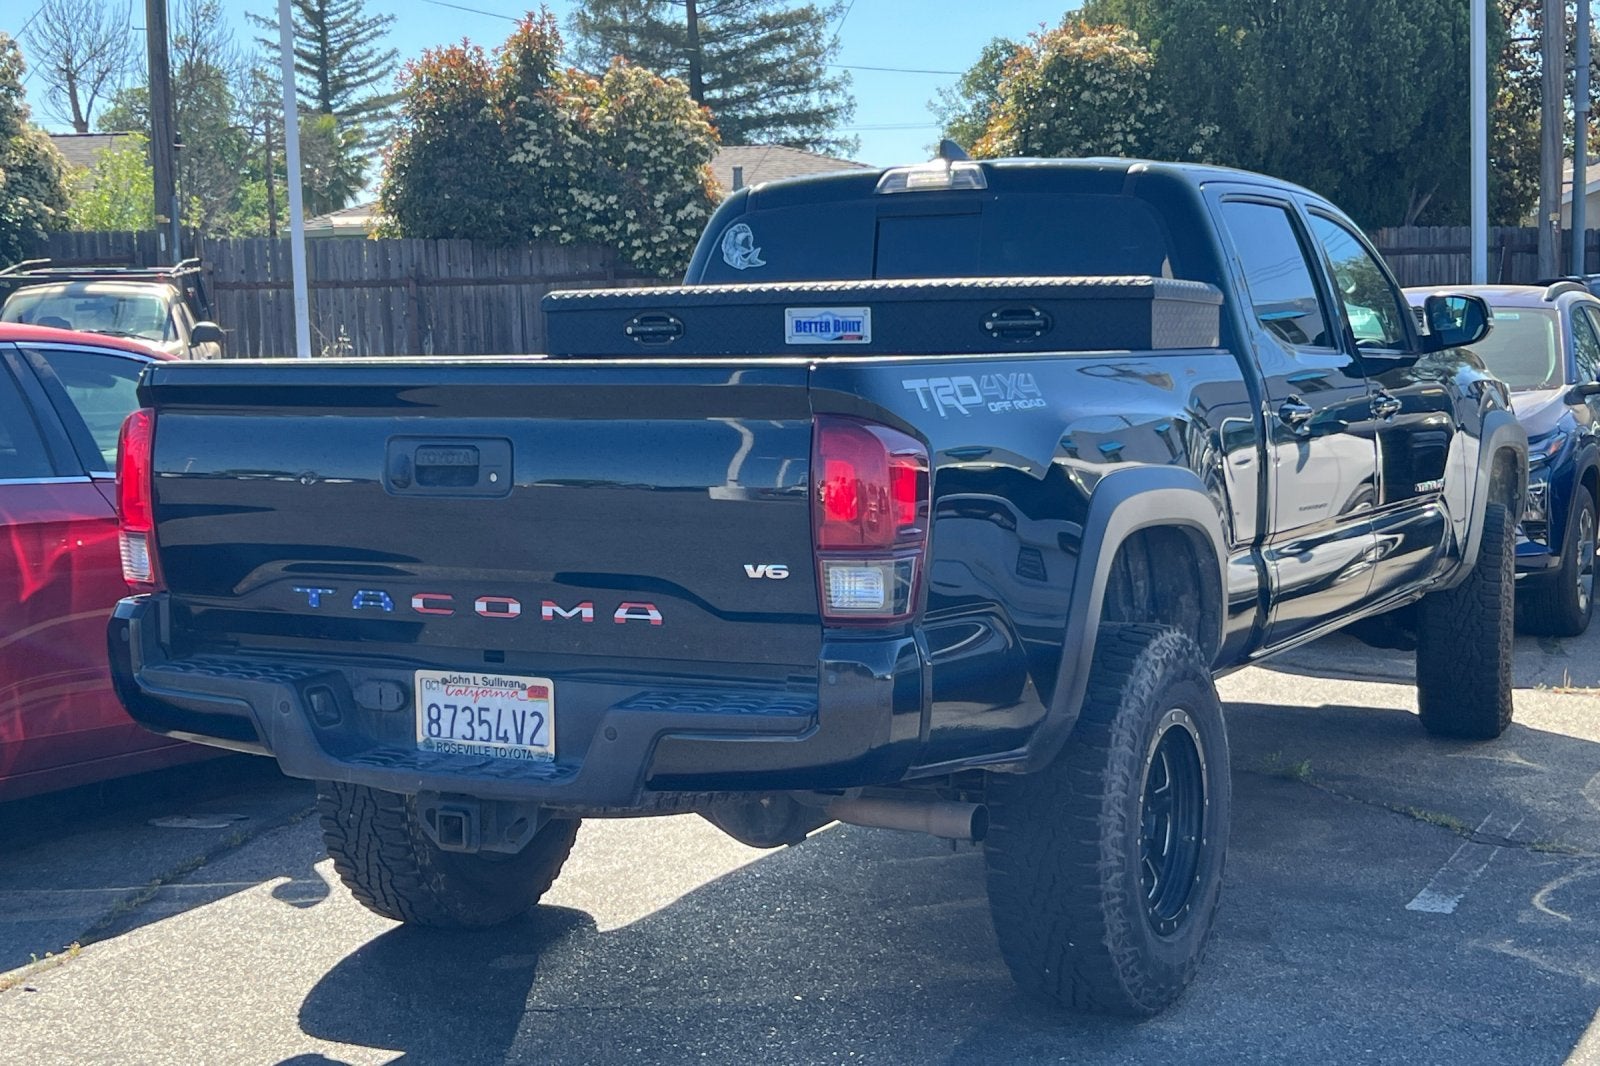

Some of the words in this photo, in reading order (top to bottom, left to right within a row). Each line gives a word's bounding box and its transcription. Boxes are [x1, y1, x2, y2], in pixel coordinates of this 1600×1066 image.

[794, 319, 831, 333] BETTER
[833, 319, 862, 333] BUILT
[901, 375, 983, 417] TRD
[988, 401, 1012, 412] OFF
[1013, 398, 1046, 410] ROAD
[743, 564, 789, 579] V6
[292, 586, 663, 625] TACOMA
[446, 675, 471, 685] John
[473, 676, 479, 686] L
[482, 676, 520, 689] Sullivan
[445, 685, 523, 703] California
[427, 703, 544, 747] 87354V2
[436, 741, 491, 757] ROSEVILLE
[493, 746, 534, 760] TOYOTA
